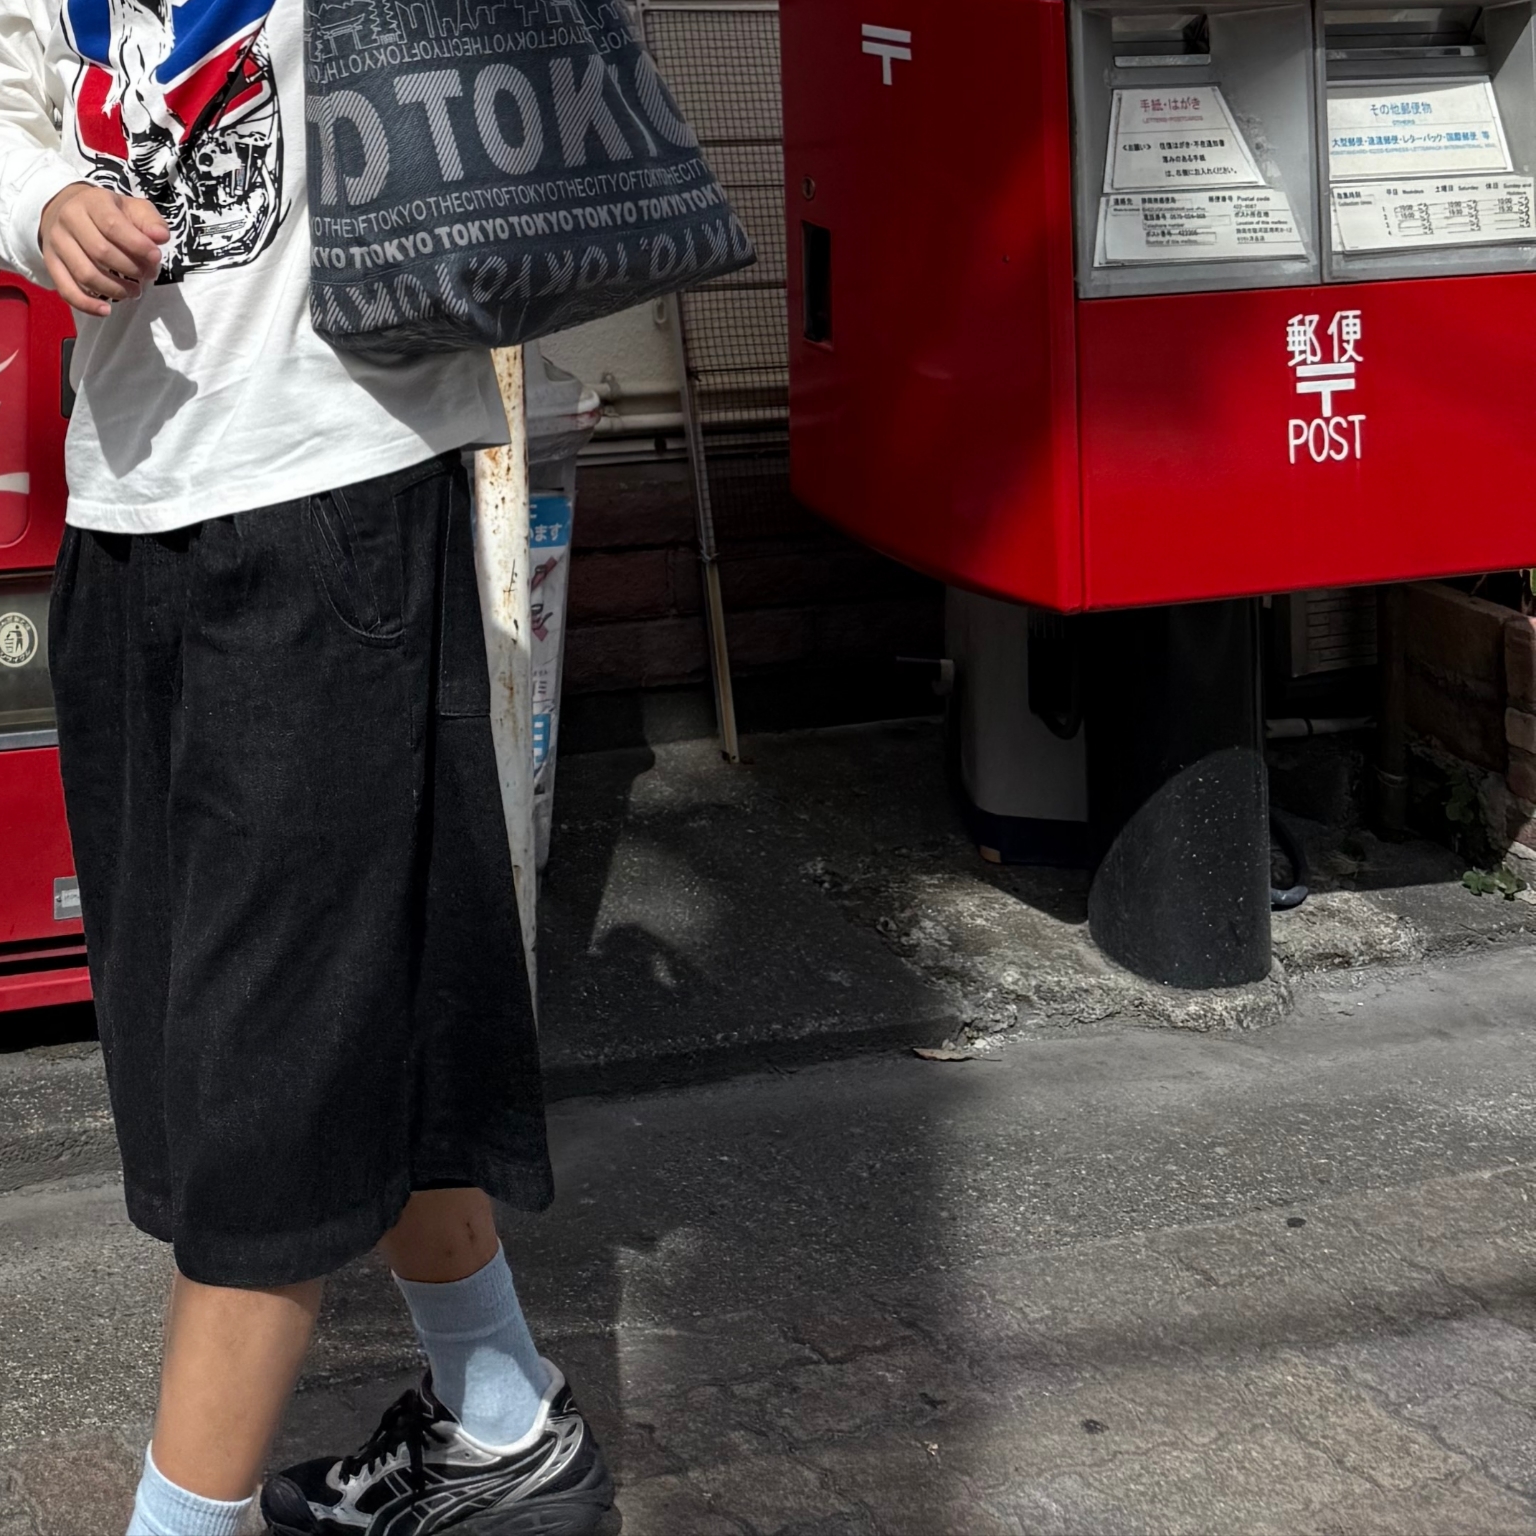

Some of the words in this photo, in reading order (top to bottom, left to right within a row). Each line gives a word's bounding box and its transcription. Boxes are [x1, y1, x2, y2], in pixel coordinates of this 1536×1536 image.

[1139, 97, 1201, 112] 手紙・はがき
[1370, 101, 1433, 116] その他郵便物
[435, 216, 510, 252] TOKYO
[511, 209, 573, 237] TOKYO
[576, 200, 637, 232] TOKYO
[1286, 309, 1362, 366] 郵便
[1288, 414, 1366, 463] POST
